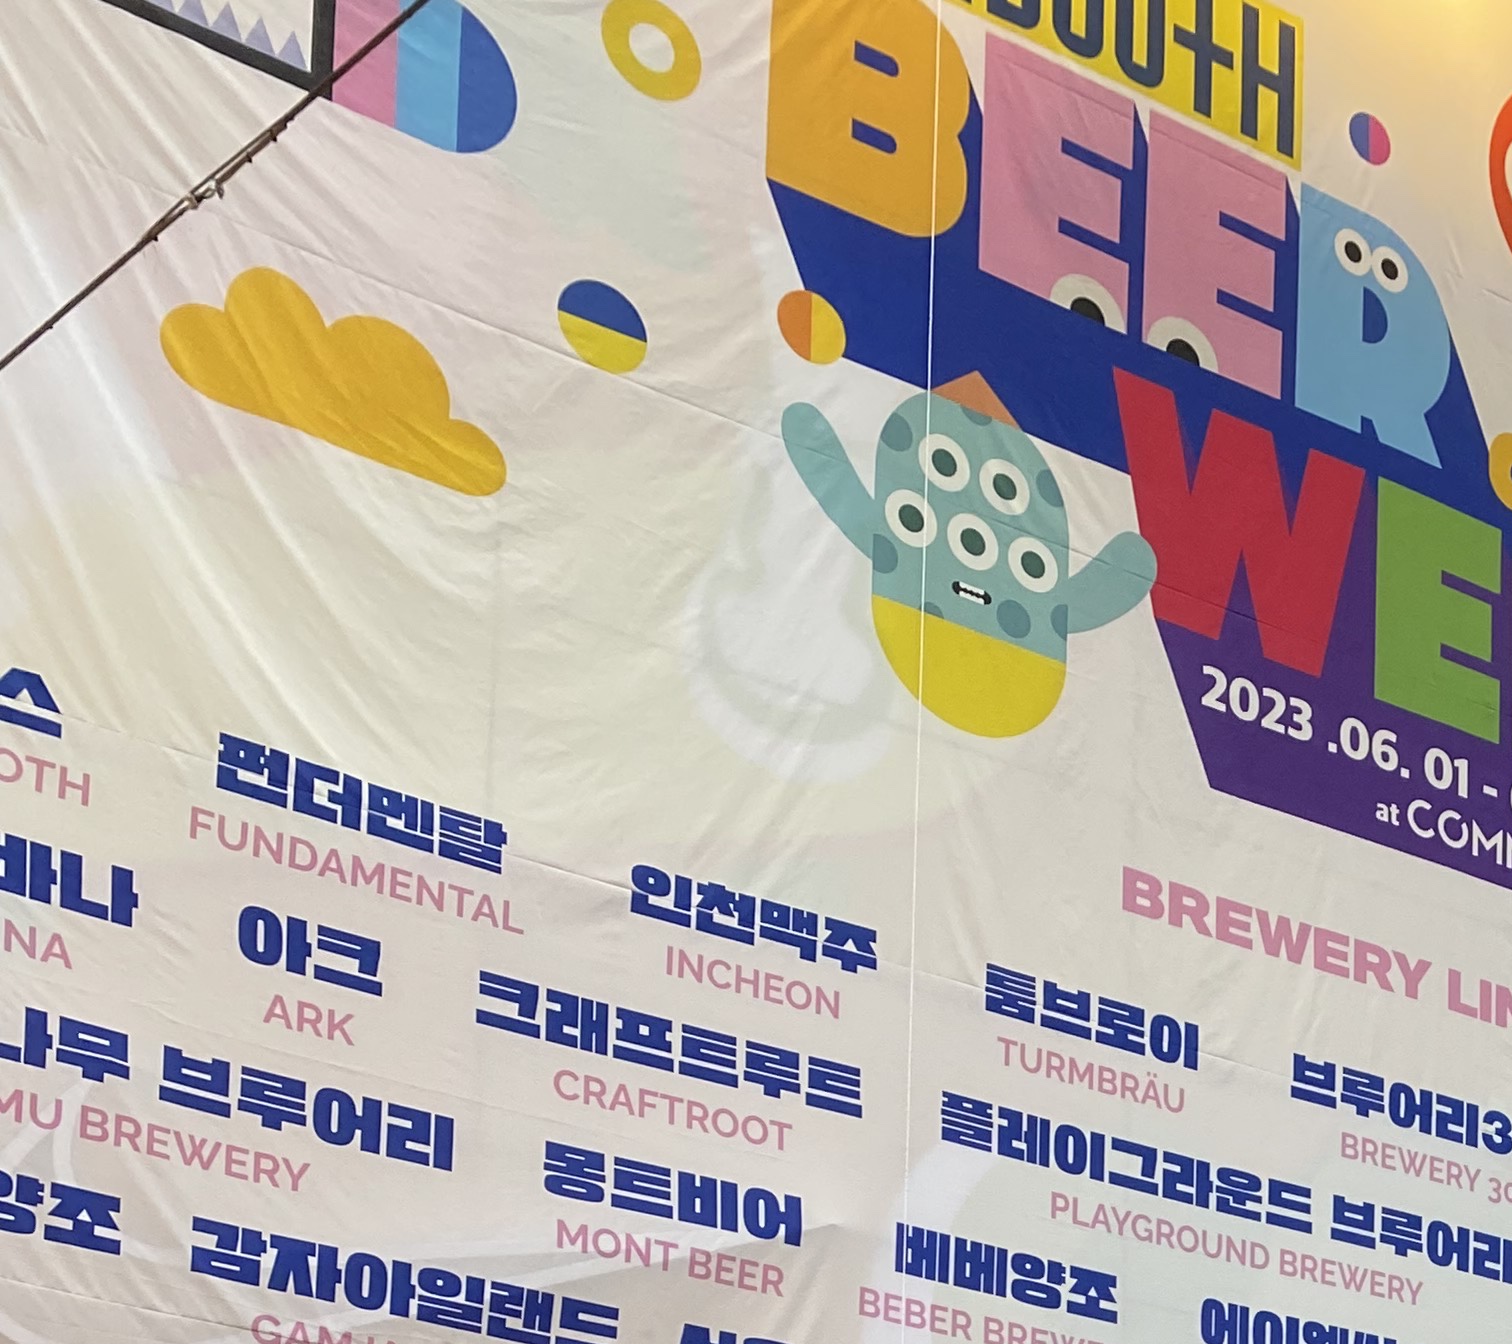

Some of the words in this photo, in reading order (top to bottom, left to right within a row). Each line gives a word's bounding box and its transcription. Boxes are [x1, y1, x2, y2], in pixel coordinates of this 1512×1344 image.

[766, 0, 1450, 468] BEER
[1200, 665, 1314, 742] 2023
[1425, 748, 1469, 797] 01
[216, 730, 507, 875] 펀더멘탈
[1375, 800, 1399, 827] at
[189, 806, 524, 935] FUNDAMENTAL
[630, 864, 877, 973] 인천맥주
[238, 905, 383, 997] 아크
[666, 946, 841, 1019] INCHEON
[1122, 865, 1432, 1001] BREWERY
[263, 995, 355, 1046] ARK
[476, 969, 863, 1119] 크래프트루트
[158, 1044, 454, 1172] 브루어리
[552, 1069, 793, 1152] CRAFTROOT
[997, 1036, 1185, 1114] TURMBRÄU
[79, 1104, 310, 1192] BREWERY
[544, 1139, 802, 1248] 몽트비어
[940, 1090, 1312, 1235] 플레이그라운드
[1340, 1132, 1481, 1193] BREWERY
[556, 1219, 680, 1272] MONT
[688, 1246, 784, 1297] BEER
[895, 1221, 1119, 1325] 베베양조
[1050, 1191, 1270, 1270] PLAYGROUND
[1279, 1250, 1423, 1306] BREWERY
[858, 1287, 972, 1342] BEBER
